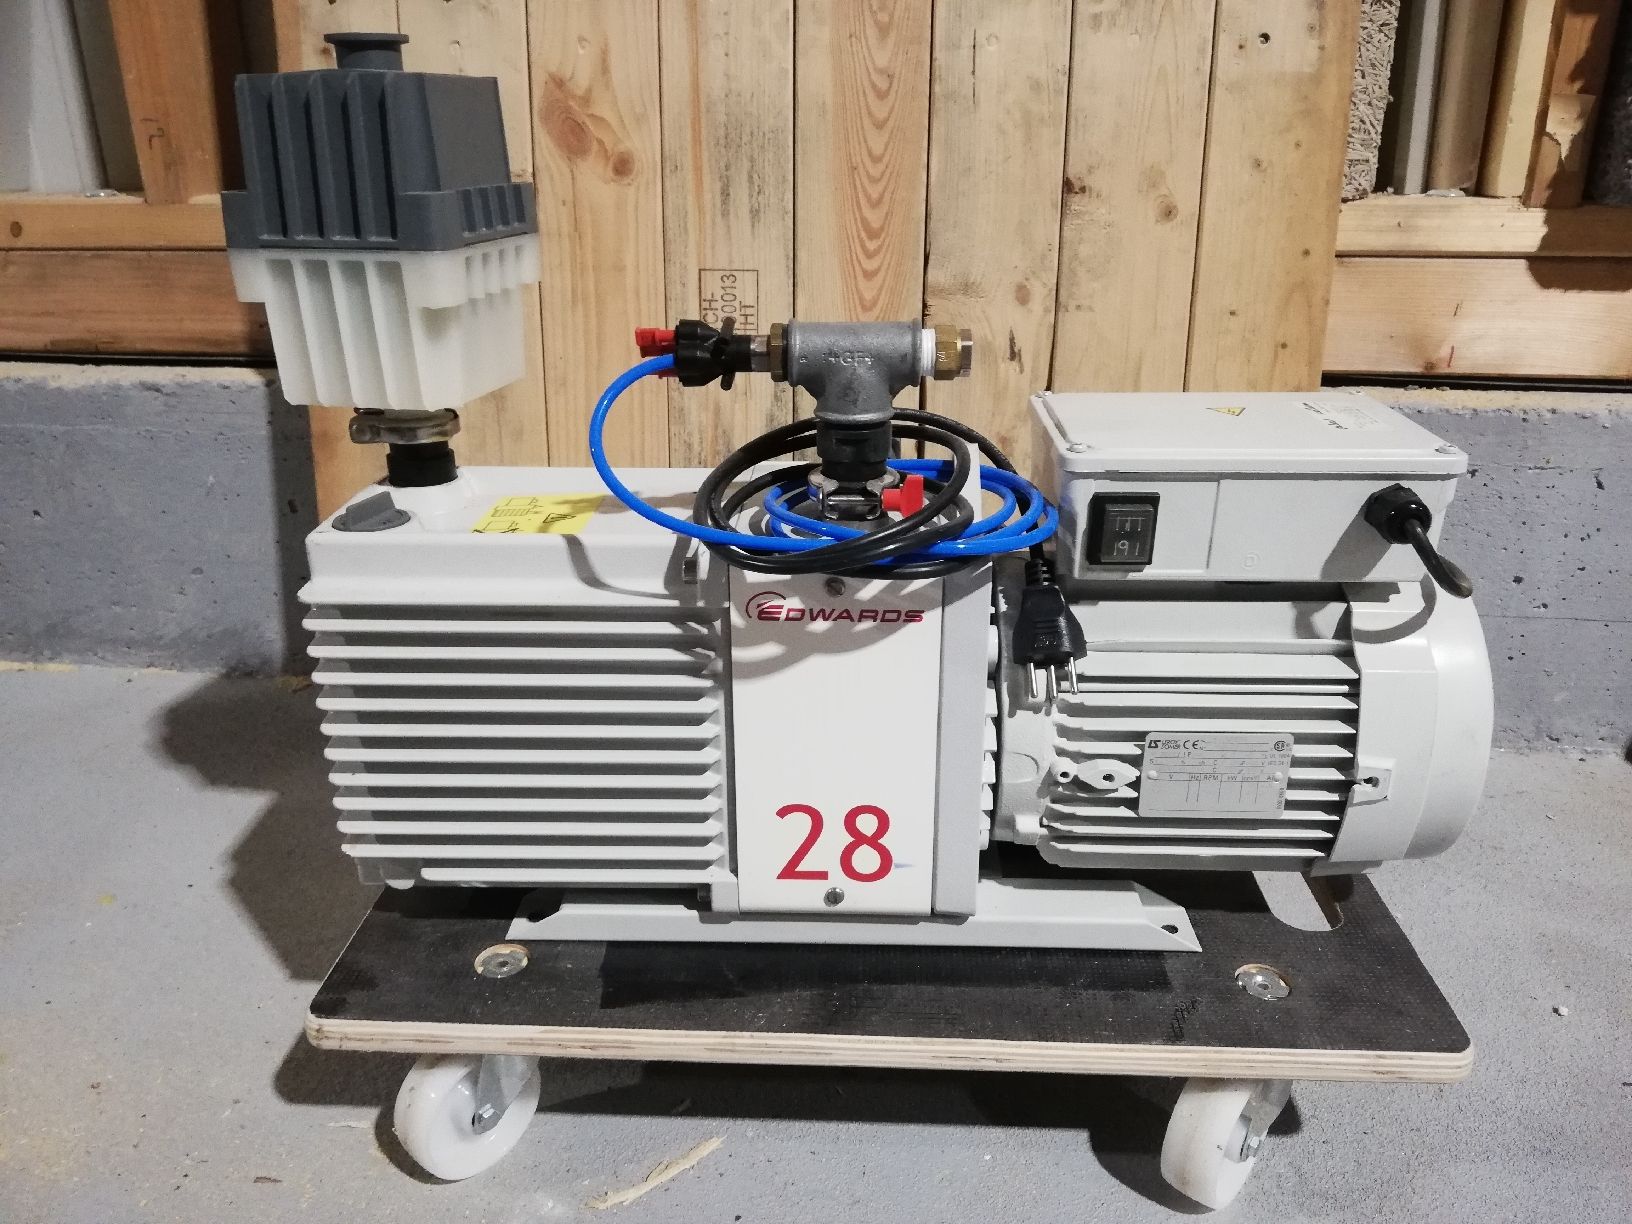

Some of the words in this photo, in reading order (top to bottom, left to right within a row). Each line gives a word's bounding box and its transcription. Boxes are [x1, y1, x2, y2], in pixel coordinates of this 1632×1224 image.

[739, 300, 755, 326] HT
[756, 600, 925, 623] EDWARDS
[775, 803, 894, 883] 28
